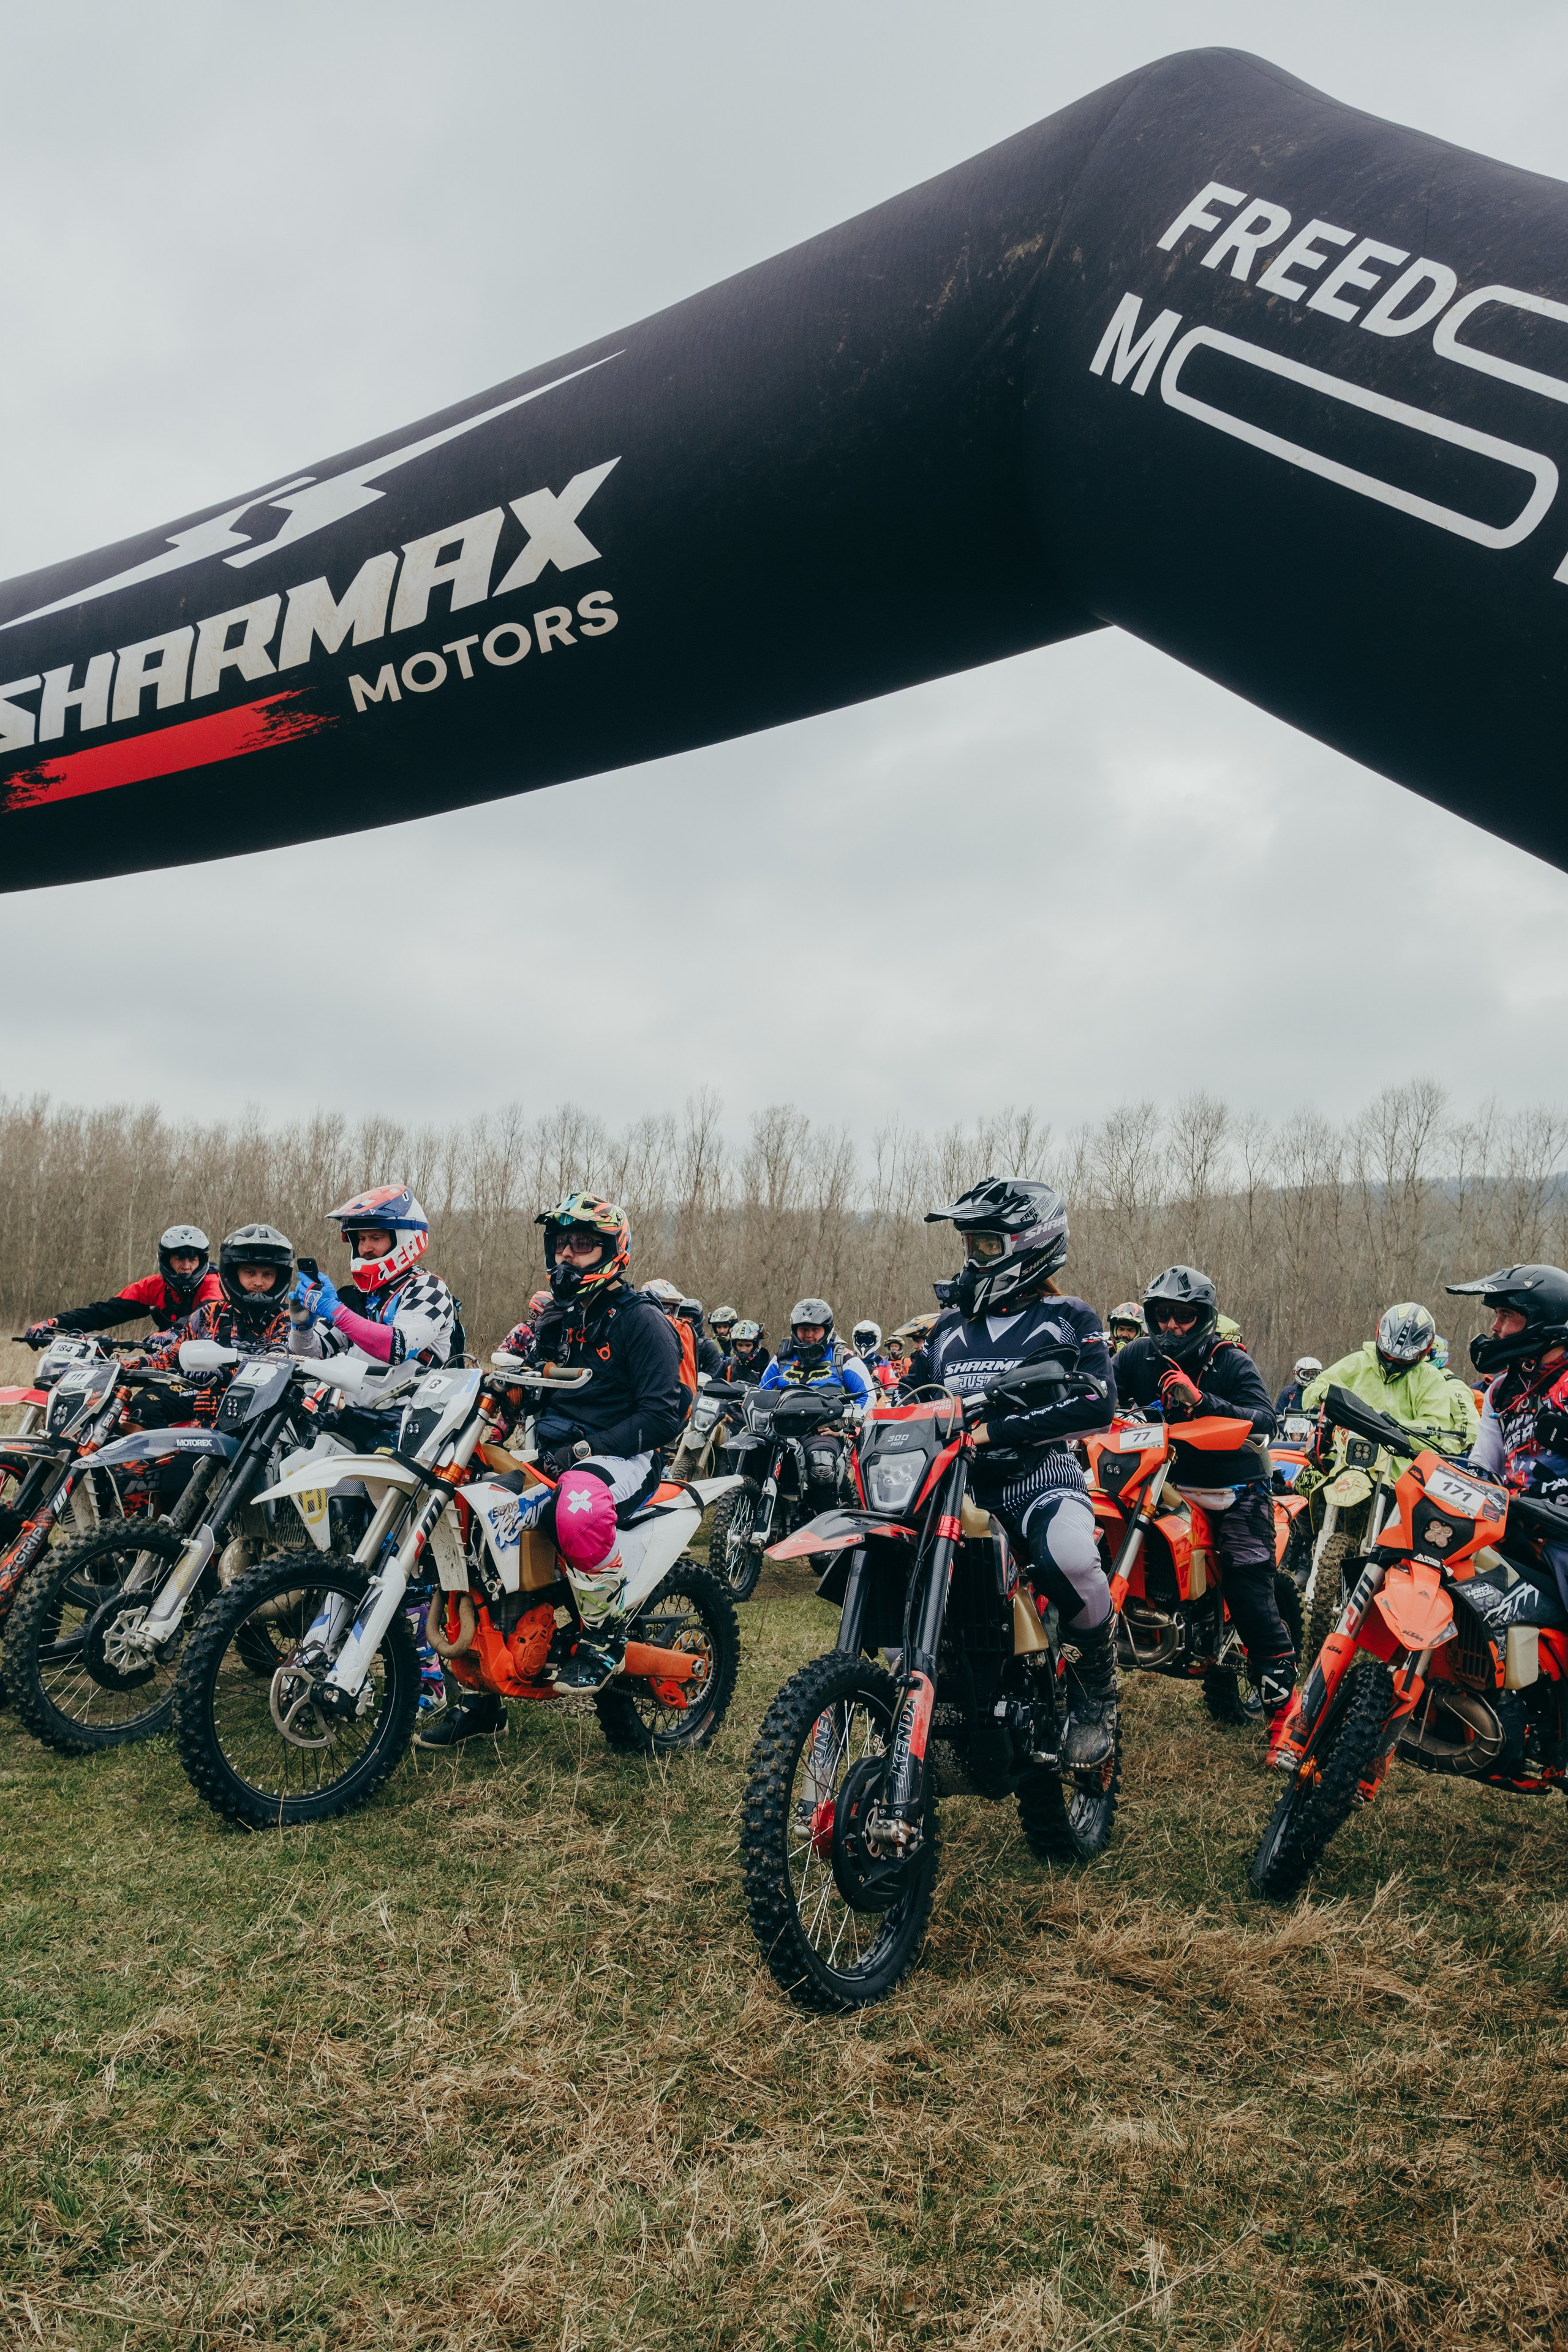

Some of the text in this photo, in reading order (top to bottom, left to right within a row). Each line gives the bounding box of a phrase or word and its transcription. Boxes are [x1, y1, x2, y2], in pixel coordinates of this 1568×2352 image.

[1089, 292, 1568, 586] MO
[348, 590, 619, 712] MOTORS
[1019, 1194, 1048, 1223] FREEDOM
[378, 1230, 428, 1281] LEAT
[1021, 1235, 1065, 1277] SHARMAX
[55, 1344, 74, 1353] 184
[69, 1373, 86, 1382] 111
[252, 1367, 261, 1377] 1
[426, 1378, 442, 1390] 13
[923, 1399, 952, 1409] EXPER
[102, 1412, 115, 1428] SES
[888, 1434, 910, 1443] 300
[1133, 1431, 1152, 1442] 77
[1442, 1481, 1473, 1502] 171
[1467, 1582, 1490, 1597] HARD
[1473, 1589, 1494, 1600] ENDURO
[1402, 1629, 1424, 1643] KTM
[1325, 1645, 1343, 1655] KTM
[808, 1706, 836, 1768] ENDA
[891, 1697, 918, 1777] KENDA
